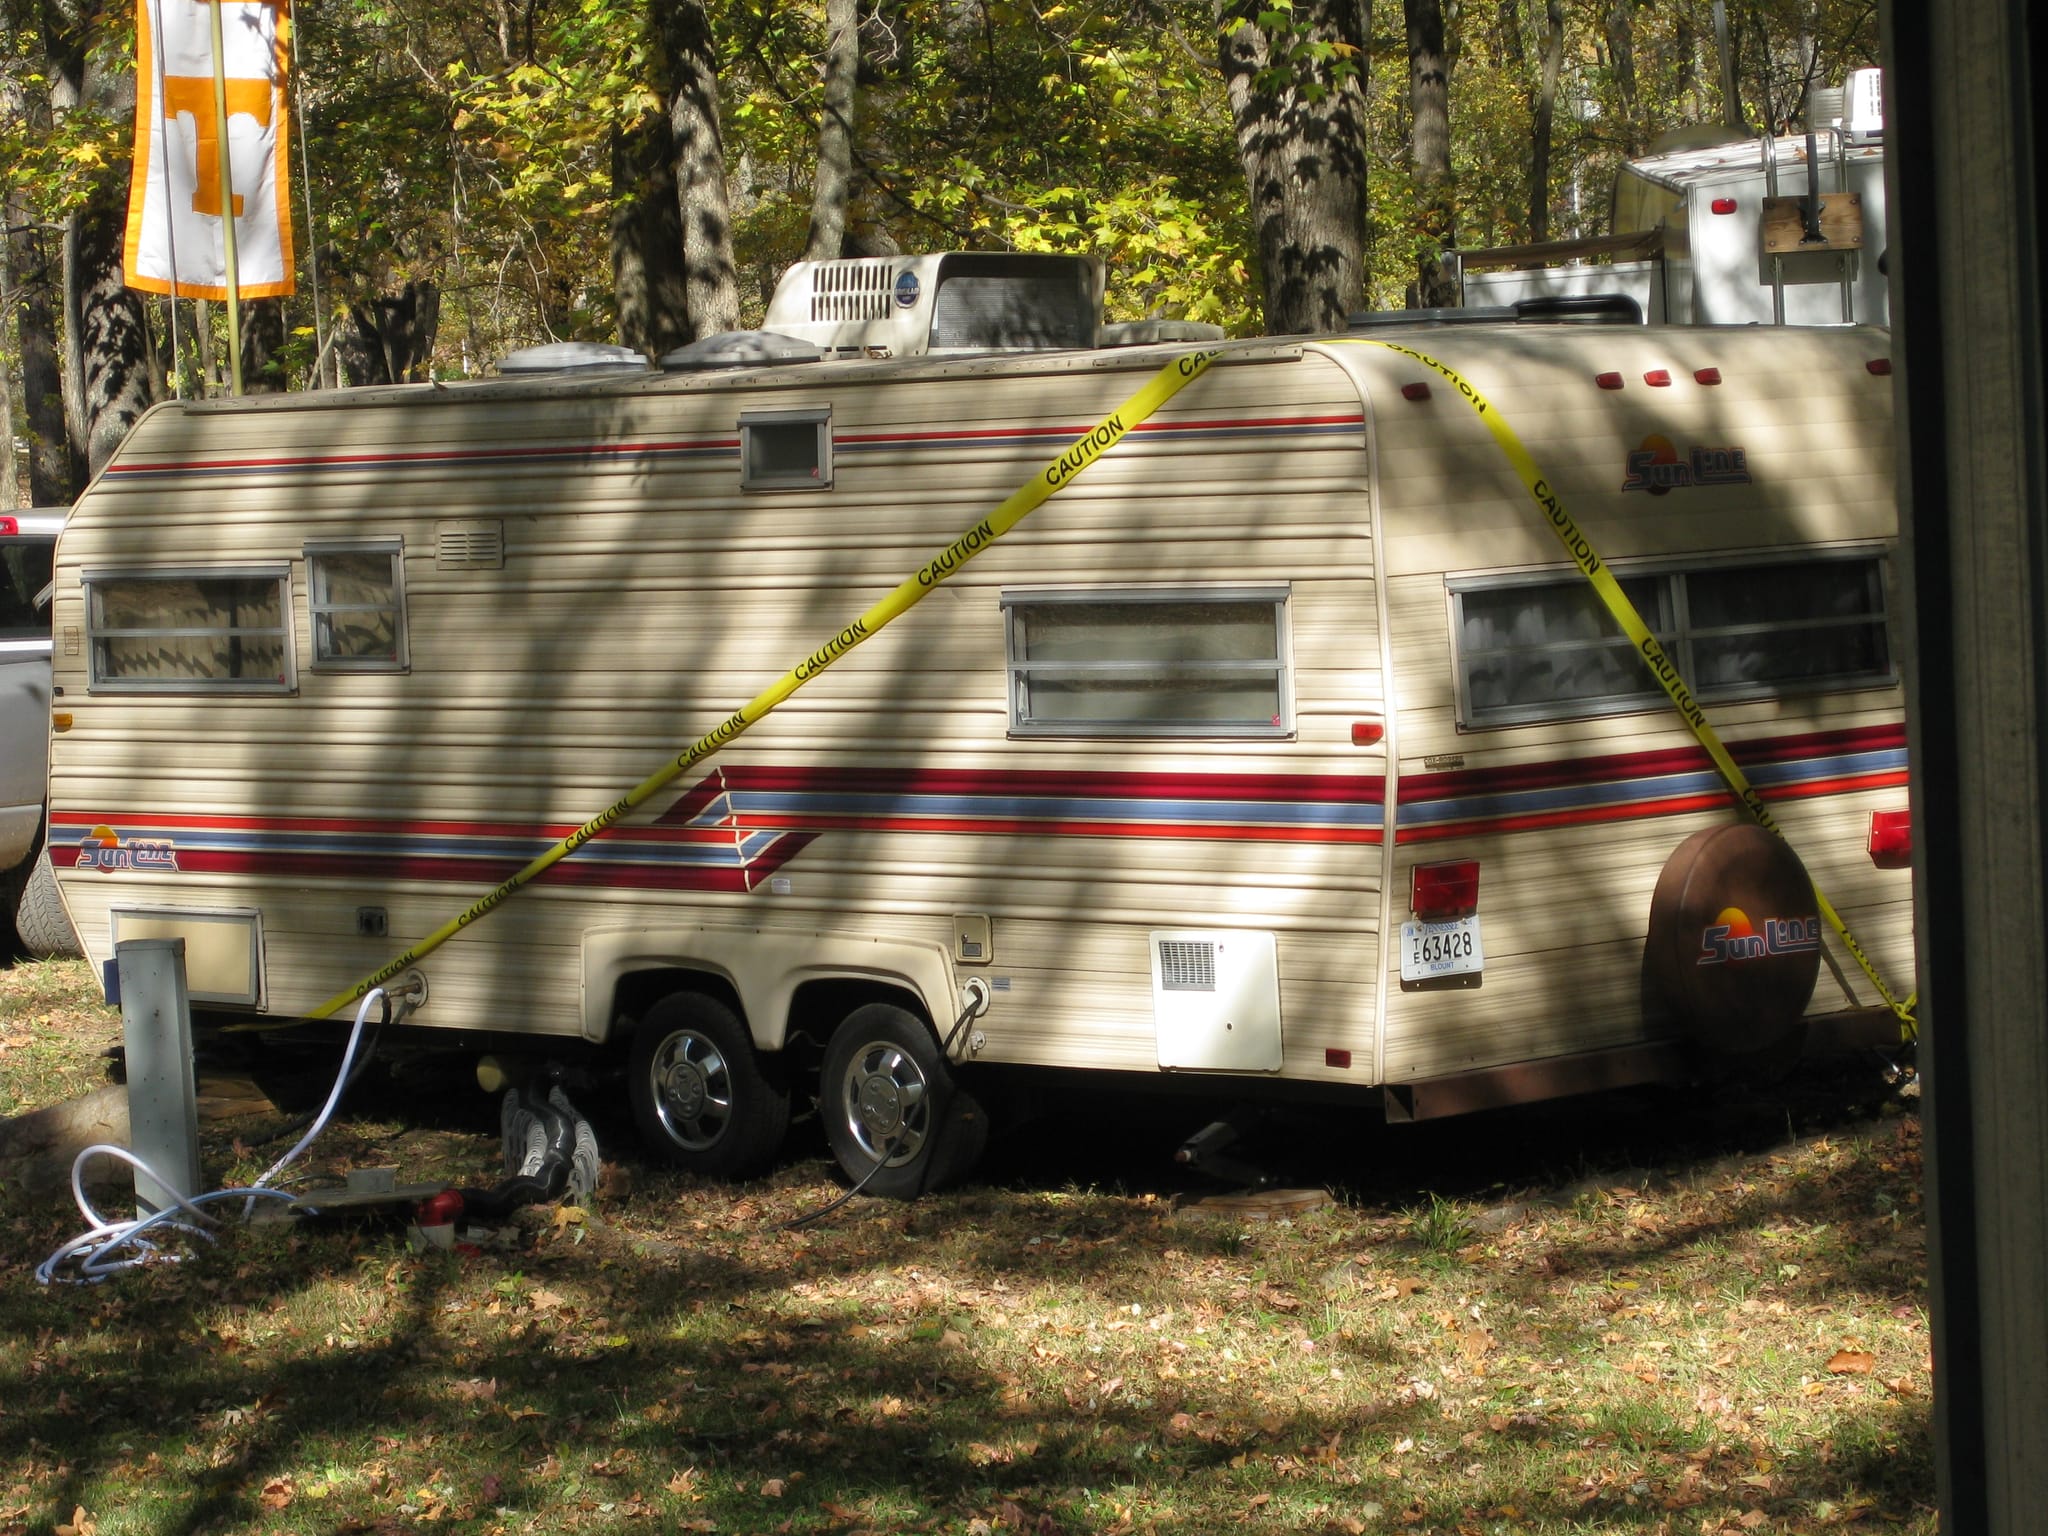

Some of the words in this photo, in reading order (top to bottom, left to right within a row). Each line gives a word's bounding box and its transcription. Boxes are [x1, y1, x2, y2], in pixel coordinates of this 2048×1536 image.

[164, 75, 272, 217] T
[1386, 343, 1487, 414] CAUTION
[1045, 414, 1124, 486] CAUTION
[918, 520, 994, 587] CAUTION
[1533, 479, 1600, 575] CAUTION
[794, 618, 868, 681] CAUTION
[1641, 637, 1706, 729] CAUTION
[676, 710, 747, 769] CAUTION
[564, 797, 629, 850] CAUTION
[457, 877, 519, 927] CAUTION
[356, 951, 416, 999] CAUTION
[1423, 931, 1472, 962] 63428
[1430, 961, 1454, 971] BLOUNT
